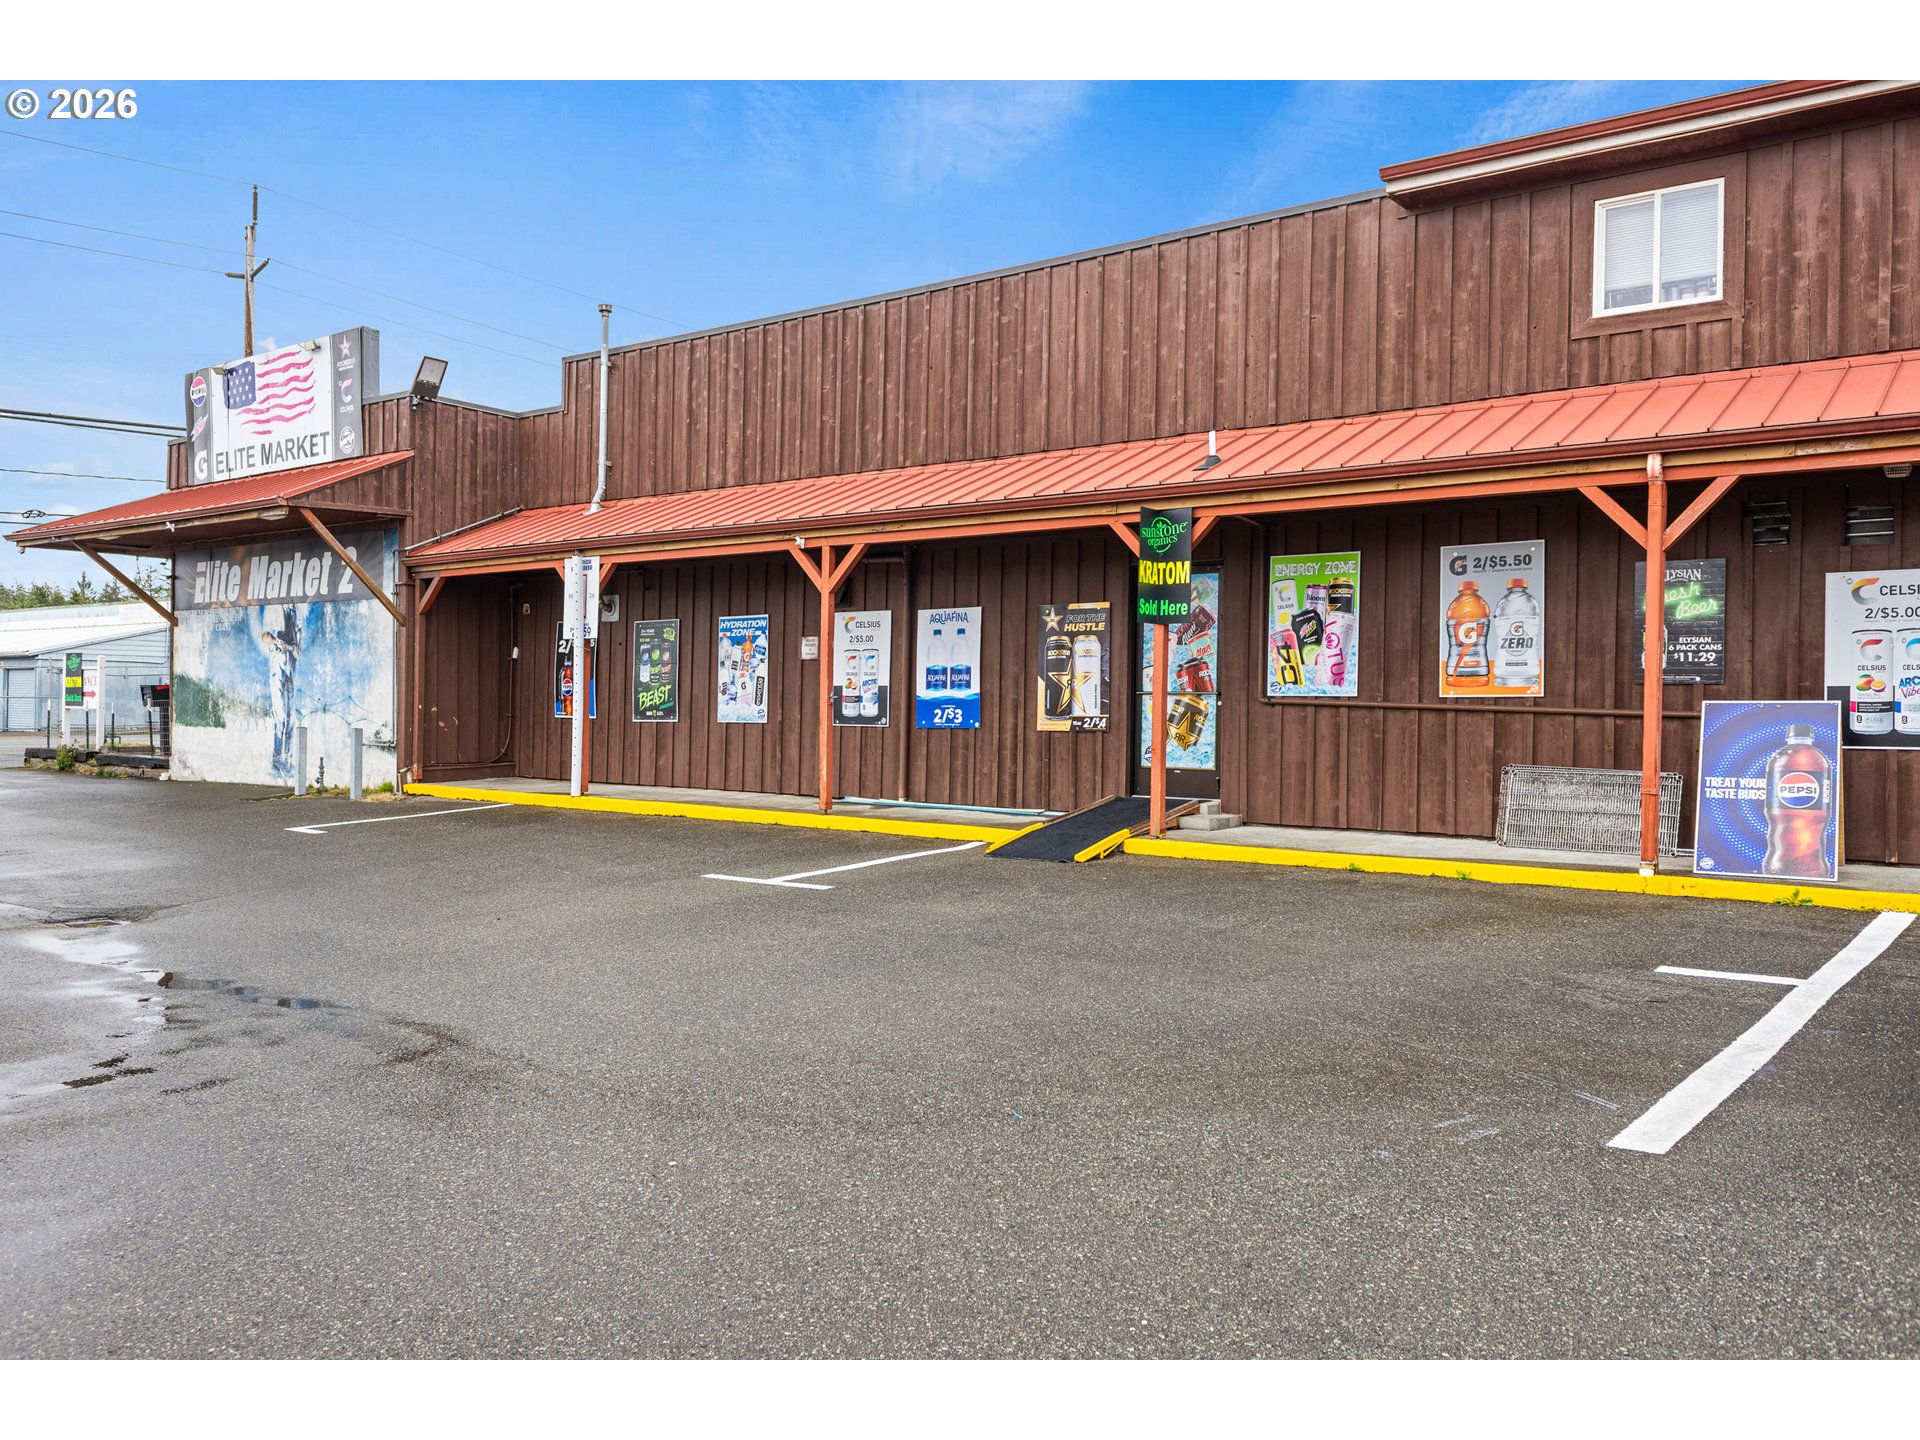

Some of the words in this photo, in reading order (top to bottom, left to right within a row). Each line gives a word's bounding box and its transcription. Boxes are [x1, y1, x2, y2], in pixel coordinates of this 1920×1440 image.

[215, 445, 256, 475] ELITE
[260, 431, 330, 467] MARKET
[1141, 521, 1188, 539] sunstone
[1147, 534, 1178, 549] organics
[1275, 562, 1321, 577] ENERGY
[1325, 560, 1356, 575] ZONE
[1473, 554, 1532, 570] 2/$5.50
[247, 552, 332, 600] Market
[338, 546, 357, 594] 2
[1139, 560, 1191, 585] KRATOM
[1665, 568, 1701, 581] LYSIAN
[1306, 593, 1326, 602] Bloom
[1139, 598, 1158, 616] Sold
[1160, 599, 1188, 616] Here
[1676, 598, 1718, 619] Beer
[720, 619, 767, 629] HYDRATION
[929, 610, 969, 625] AQUAFINA
[1066, 614, 1086, 623] FOR
[1087, 613, 1106, 622] THE
[855, 620, 881, 629] CELSIUS
[1064, 622, 1105, 632] HUSTLE
[1510, 621, 1524, 636] G
[731, 628, 756, 637] ZONE
[849, 635, 874, 643] 2/$5.00
[1458, 621, 1477, 644] G
[1500, 637, 1534, 649] ZERO
[1699, 643, 1723, 651] CANS
[1673, 651, 1716, 662] $11.29
[638, 684, 673, 711] BEAST
[933, 708, 963, 723] 2/$3
[1083, 717, 1107, 728] 2/$4
[1705, 776, 1738, 788] TREAT
[1738, 778, 1767, 789] YOUR
[1705, 787, 1737, 799] TASTE
[1738, 789, 1767, 800] BUDS
[1779, 785, 1817, 795] PEPSI
